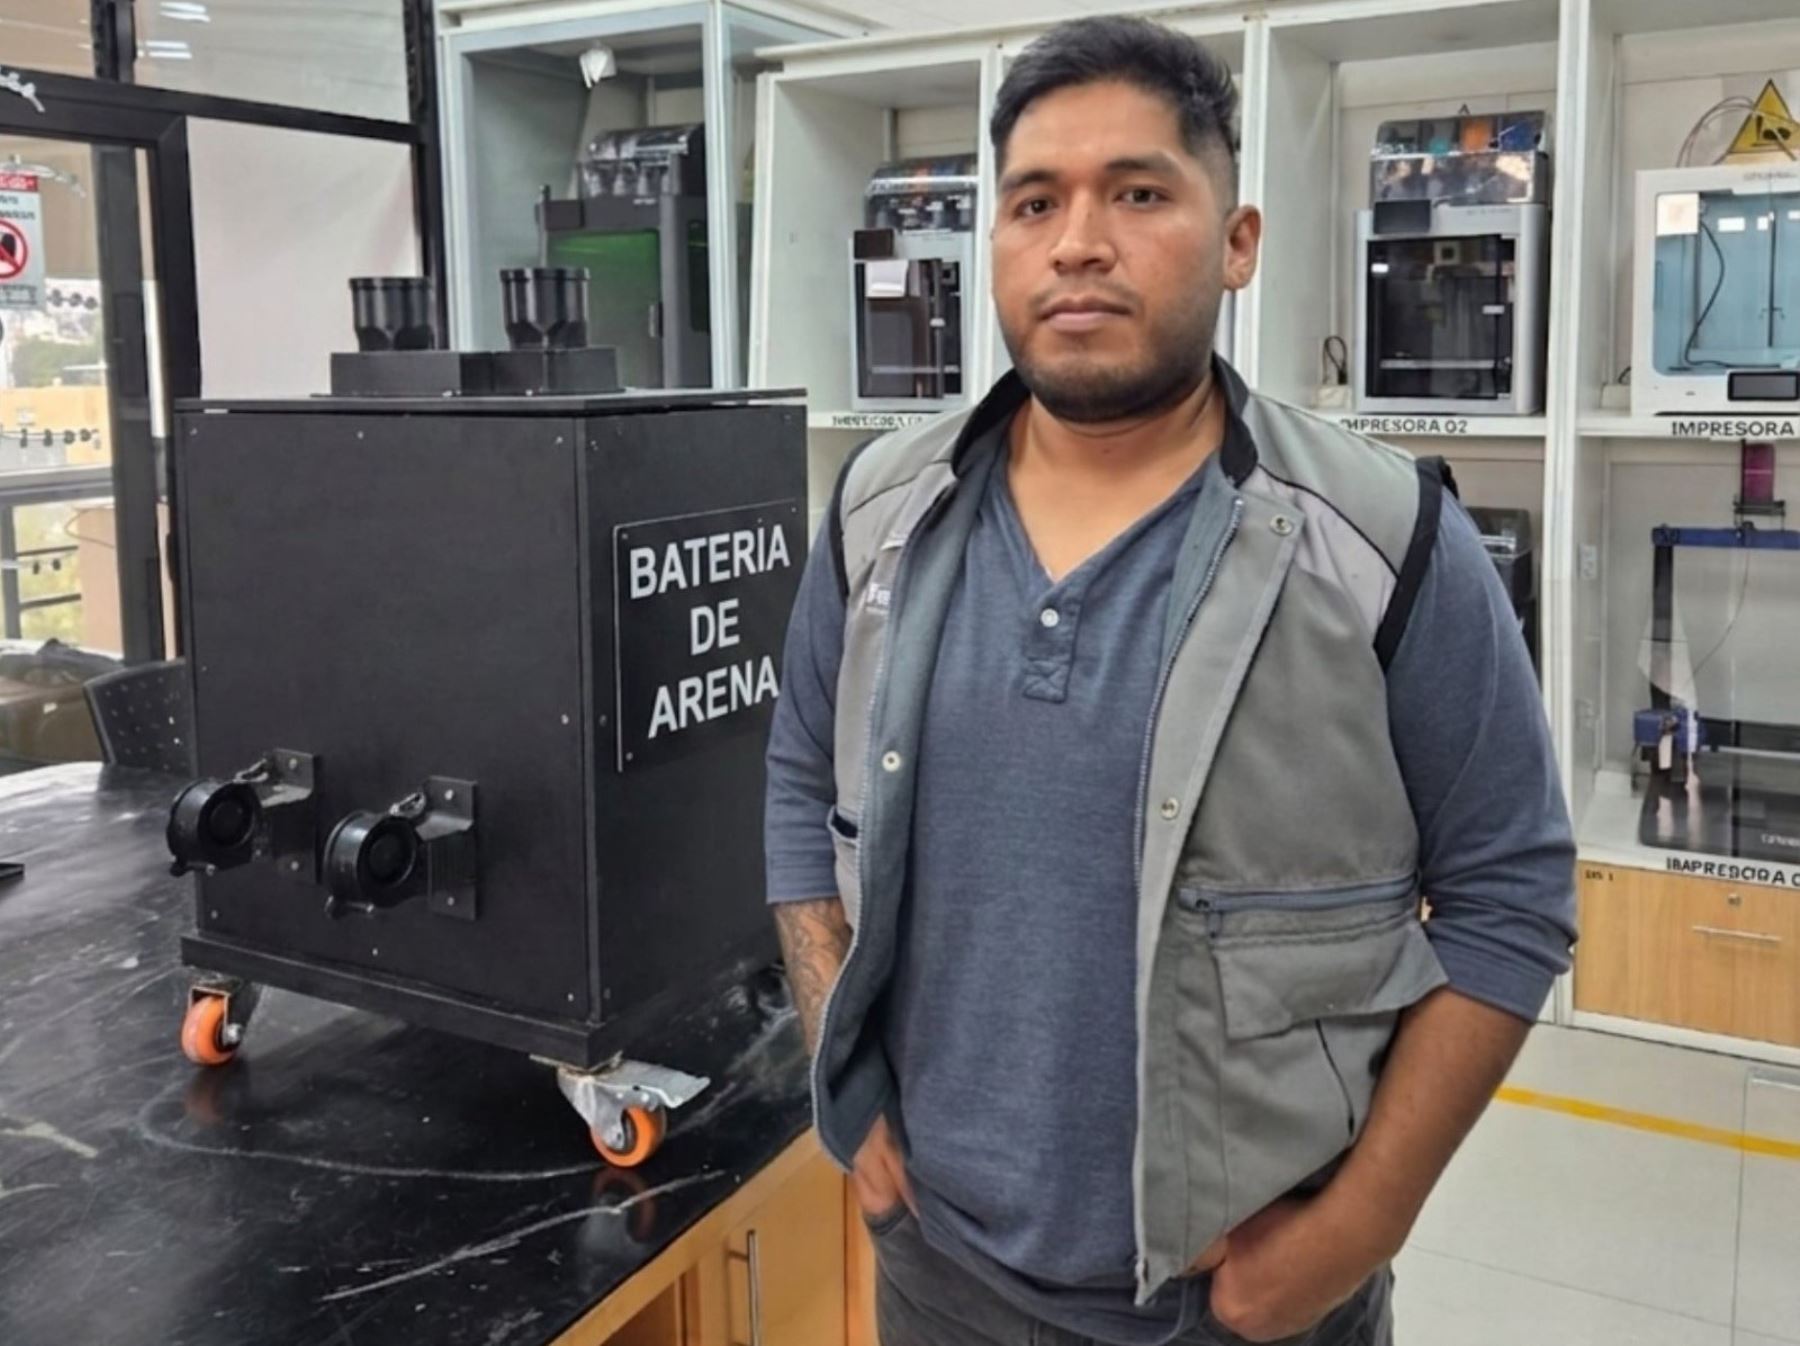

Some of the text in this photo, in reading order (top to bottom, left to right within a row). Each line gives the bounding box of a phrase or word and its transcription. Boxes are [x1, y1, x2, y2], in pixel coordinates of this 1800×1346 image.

[1671, 421, 1795, 437] IMPRESORA
[690, 598, 741, 656] DE
[648, 655, 780, 739] ARENA
